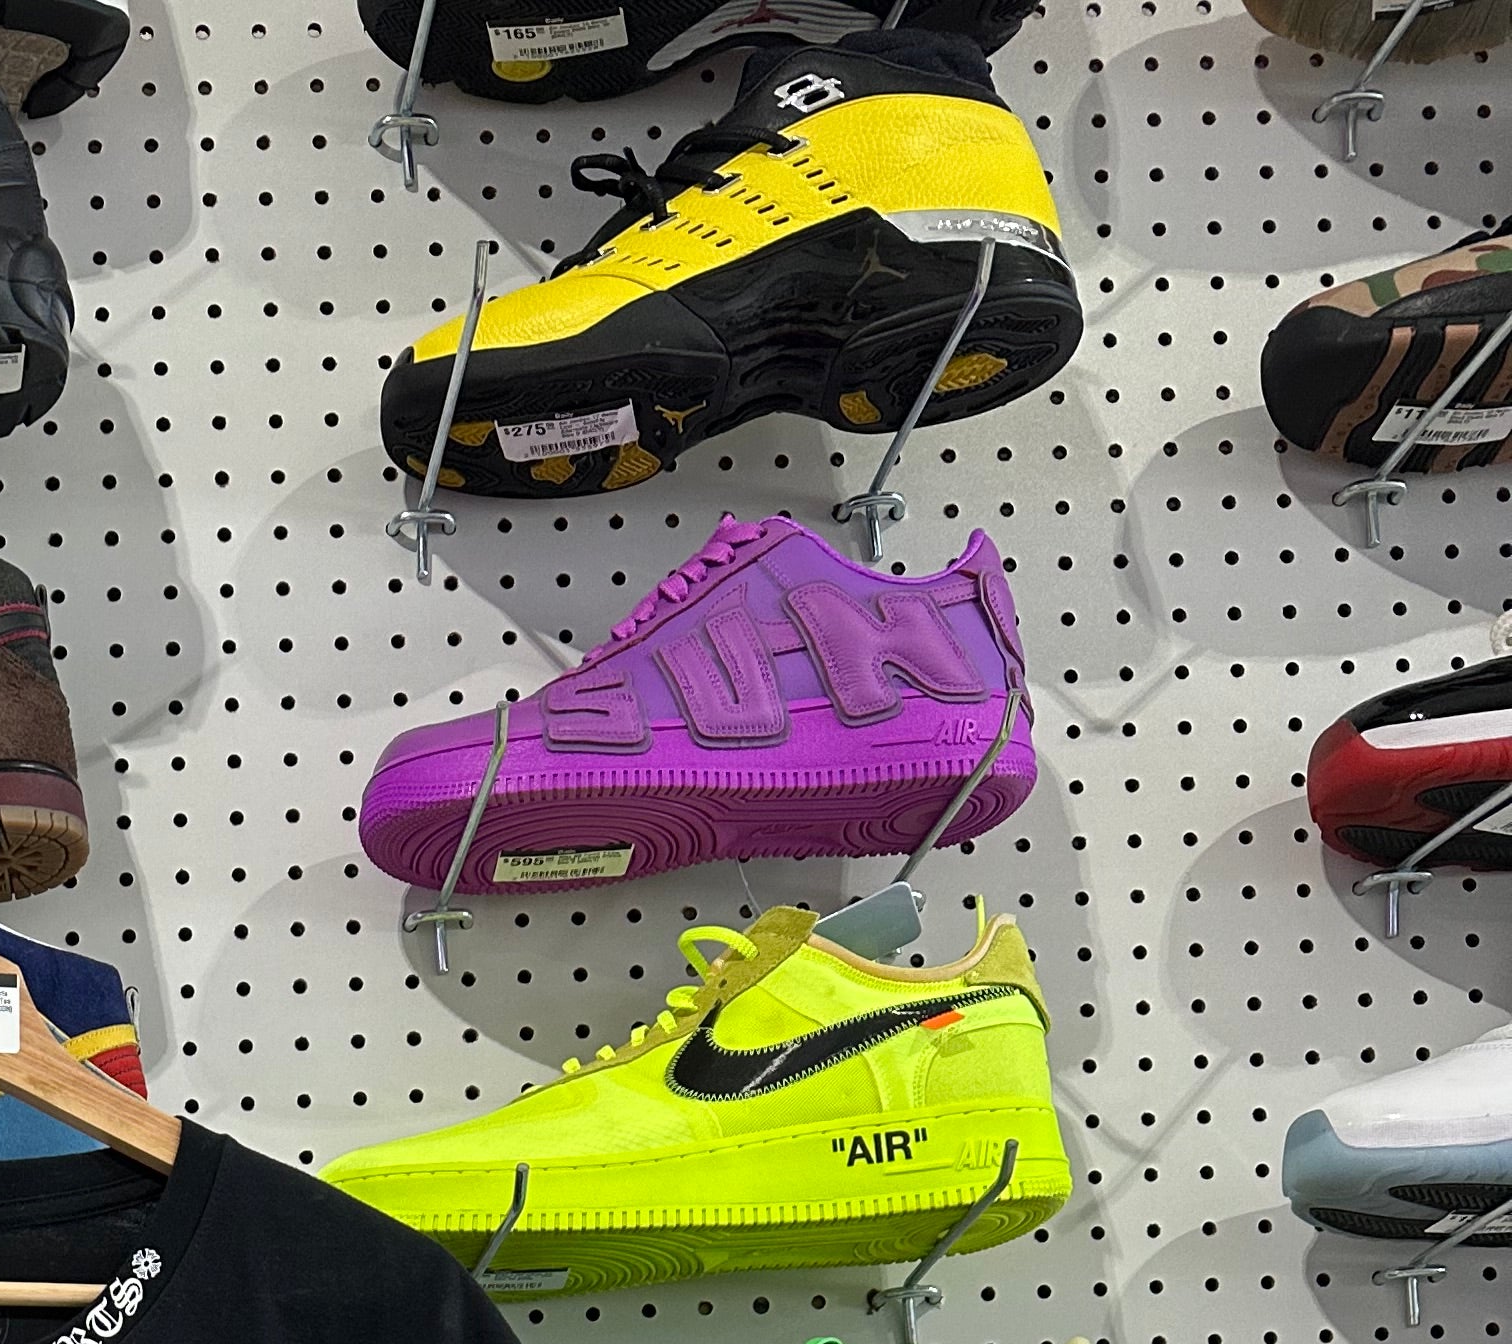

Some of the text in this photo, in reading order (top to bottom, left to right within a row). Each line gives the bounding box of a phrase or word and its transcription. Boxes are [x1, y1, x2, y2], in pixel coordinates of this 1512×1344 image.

[494, 28, 537, 40] $165
[504, 423, 547, 437] $275
[933, 719, 979, 746] AIR
[832, 1127, 928, 1167] "AIR"
